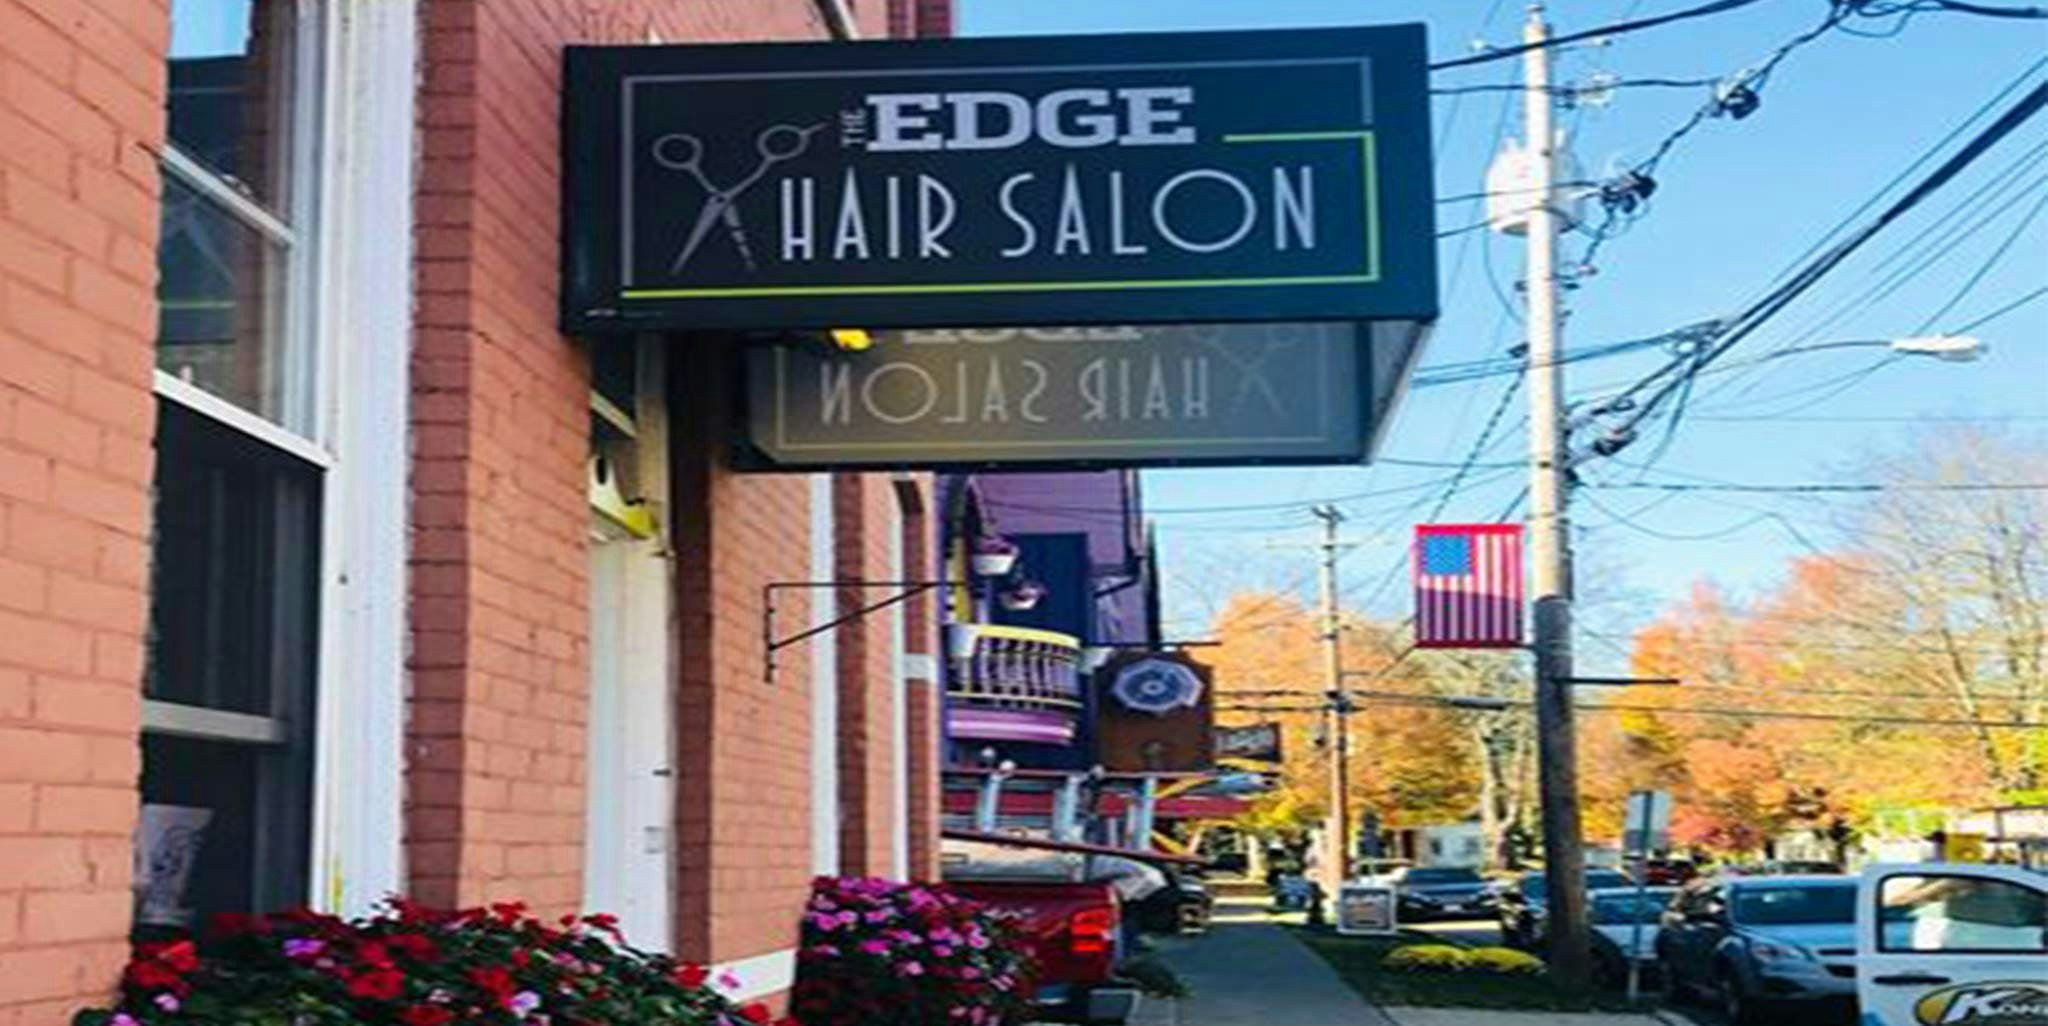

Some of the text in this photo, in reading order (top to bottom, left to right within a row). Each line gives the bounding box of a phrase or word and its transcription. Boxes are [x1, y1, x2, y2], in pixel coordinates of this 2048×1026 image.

[842, 108, 865, 147] THE
[866, 87, 1196, 151] EDGE
[782, 164, 1315, 260] HAIR SALON
